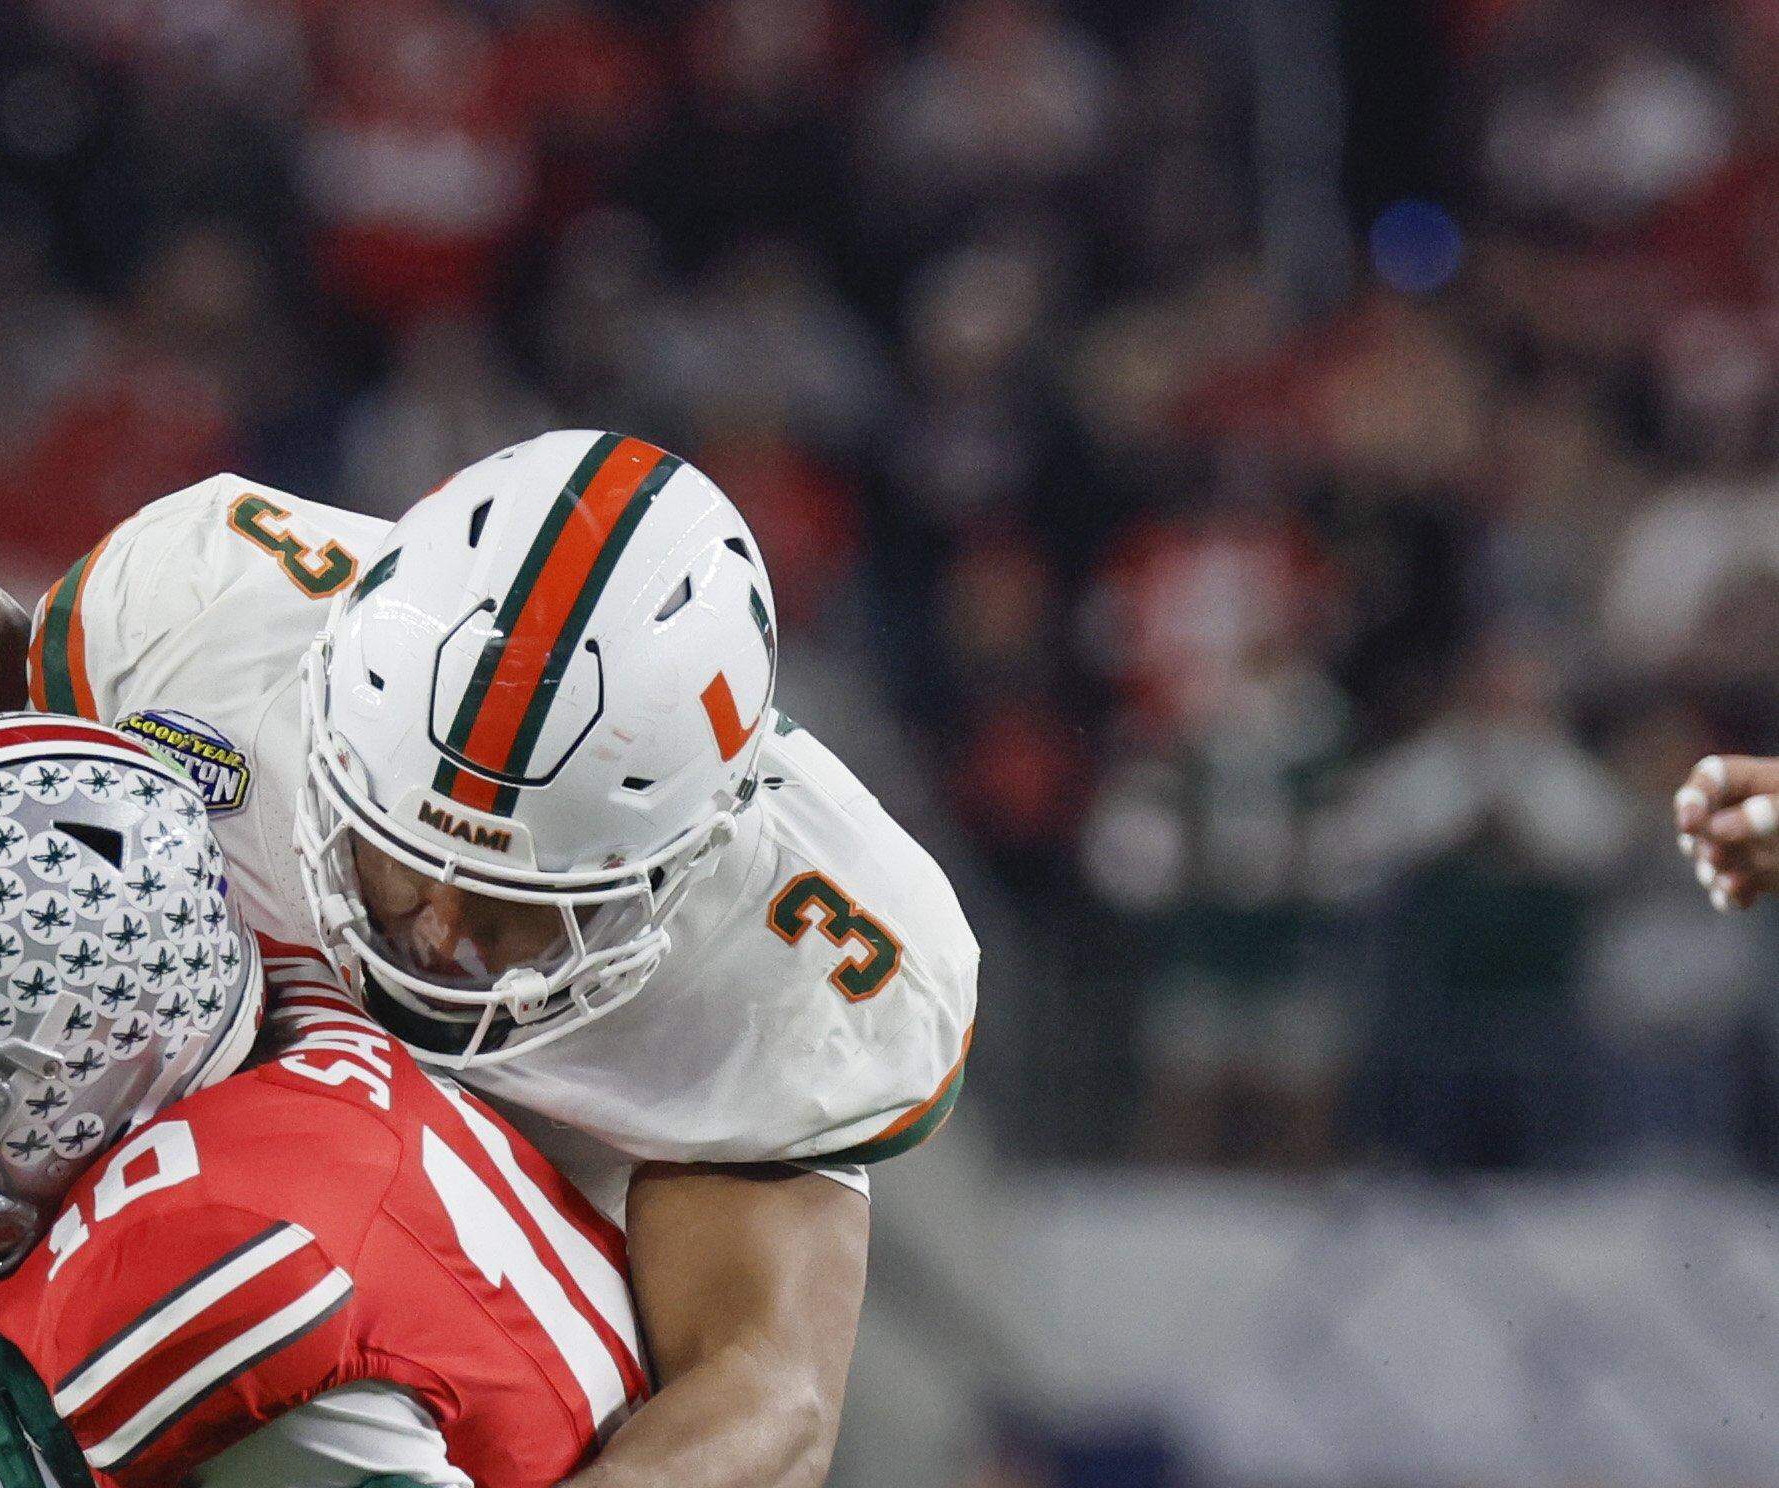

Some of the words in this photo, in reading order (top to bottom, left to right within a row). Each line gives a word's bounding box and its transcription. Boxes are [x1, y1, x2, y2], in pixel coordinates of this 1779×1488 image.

[226, 492, 360, 601] 3
[129, 715, 244, 768] GOODYEAR
[418, 799, 513, 853] MIAMI
[766, 870, 904, 1004] 3
